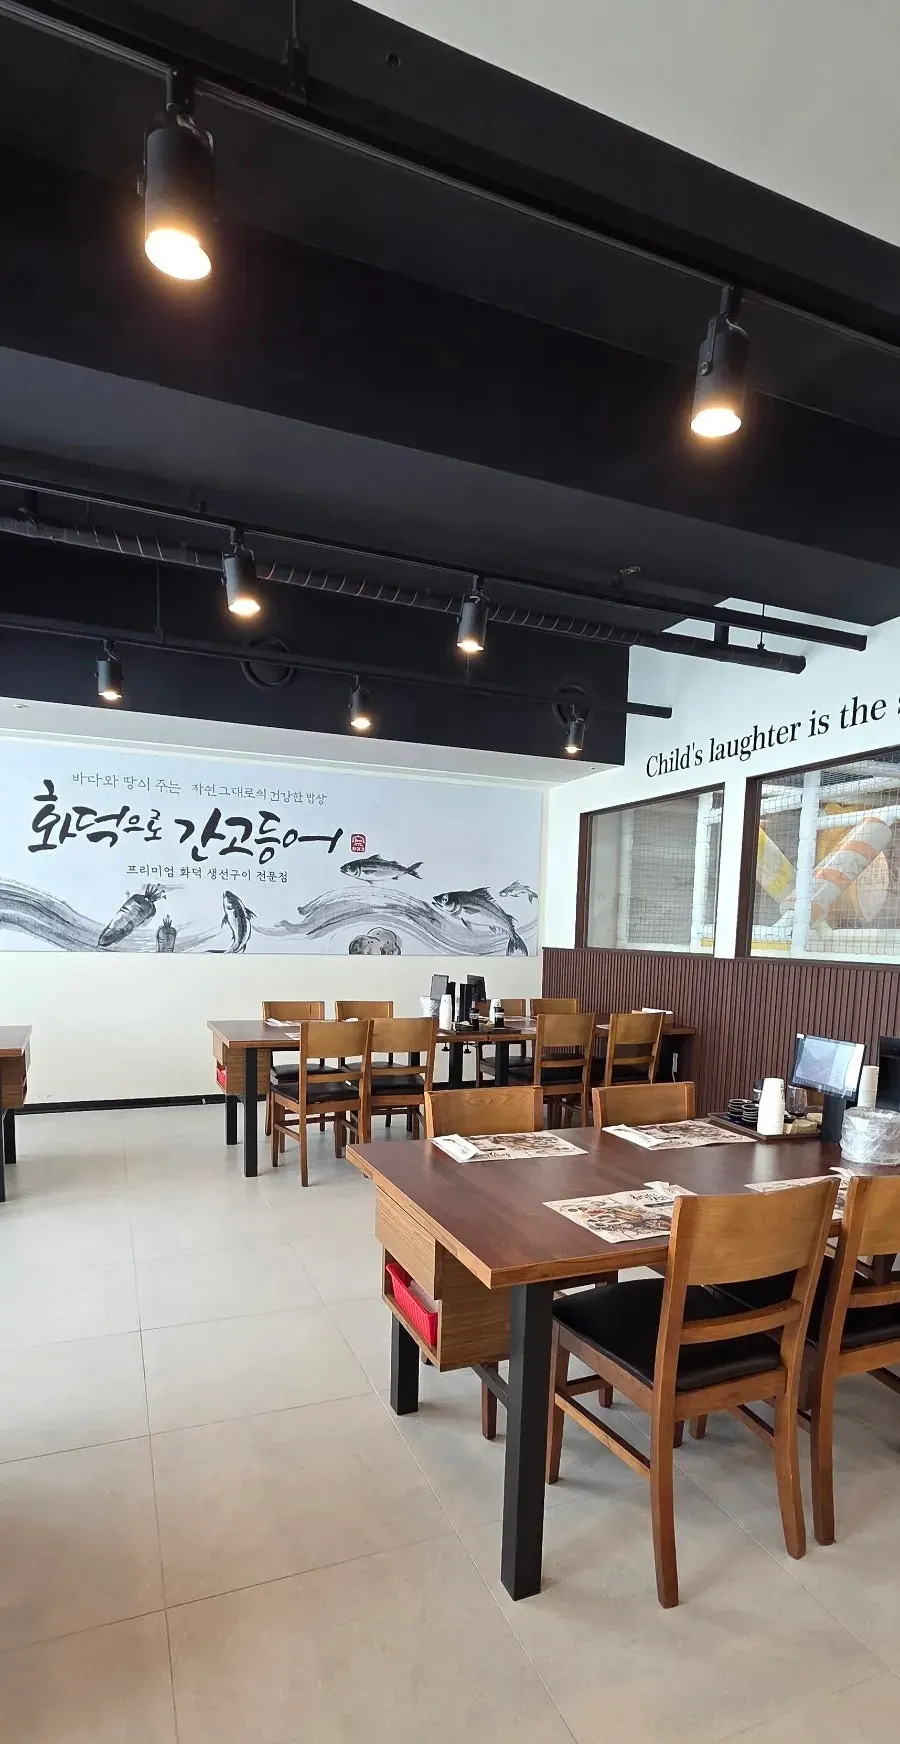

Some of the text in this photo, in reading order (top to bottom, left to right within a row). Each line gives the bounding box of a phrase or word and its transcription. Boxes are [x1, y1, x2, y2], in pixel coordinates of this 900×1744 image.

[646, 742, 703, 778] Child's
[708, 721, 801, 762] laughter
[807, 710, 830, 737] is
[840, 696, 887, 729] the
[72, 771, 119, 788] 바다와
[123, 775, 150, 791] 땅이
[154, 779, 182, 794] 주는
[269, 789, 304, 803] 건강한
[306, 792, 328, 805] 밥상
[28, 779, 344, 865] 화덕으로 간고등어
[126, 863, 289, 883] 프리미엄 화덕 생선구이 전문점
